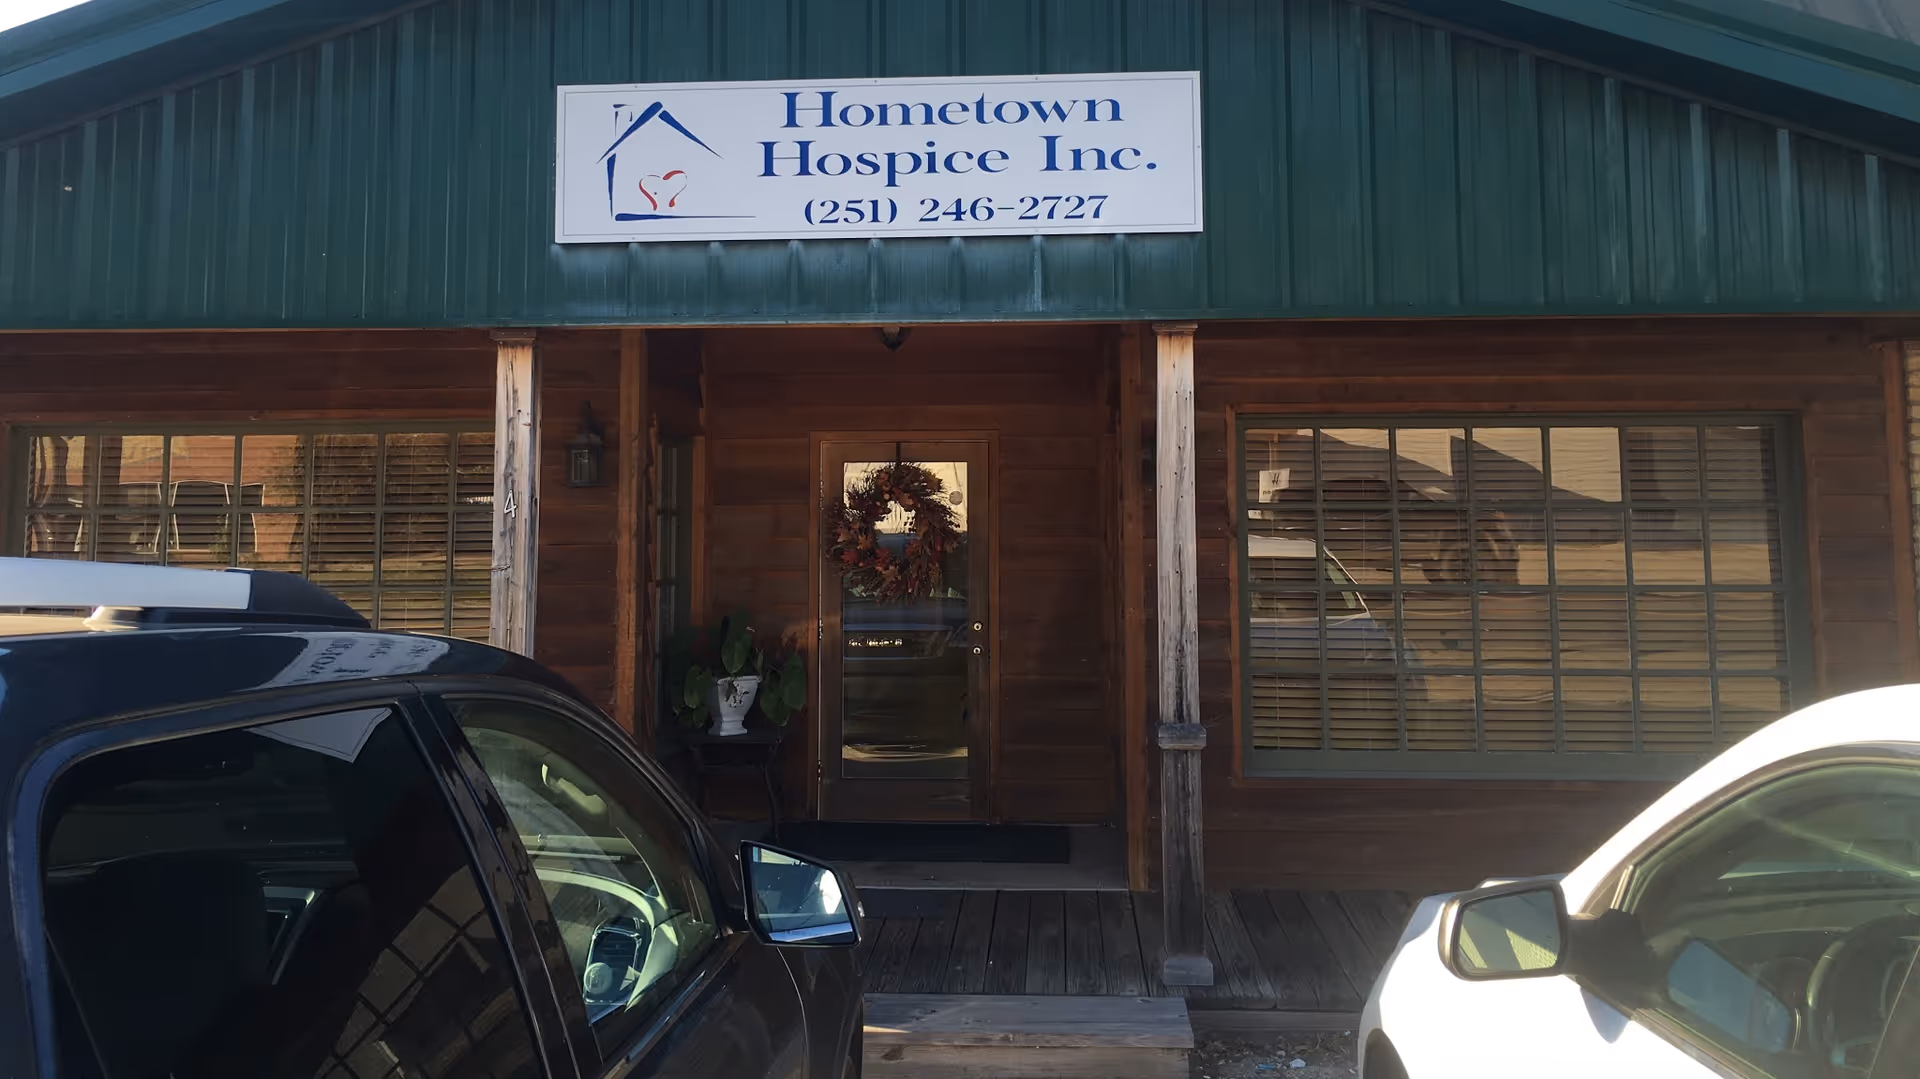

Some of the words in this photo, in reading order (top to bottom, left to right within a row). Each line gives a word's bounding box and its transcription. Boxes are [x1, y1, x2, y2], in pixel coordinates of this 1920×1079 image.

[779, 91, 1125, 129] Hometown
[756, 141, 1010, 188] Hospice
[1038, 135, 1158, 172] Inc.
[804, 197, 898, 226] (251)
[918, 194, 1109, 223] 246-2727
[503, 489, 518, 519] 4
